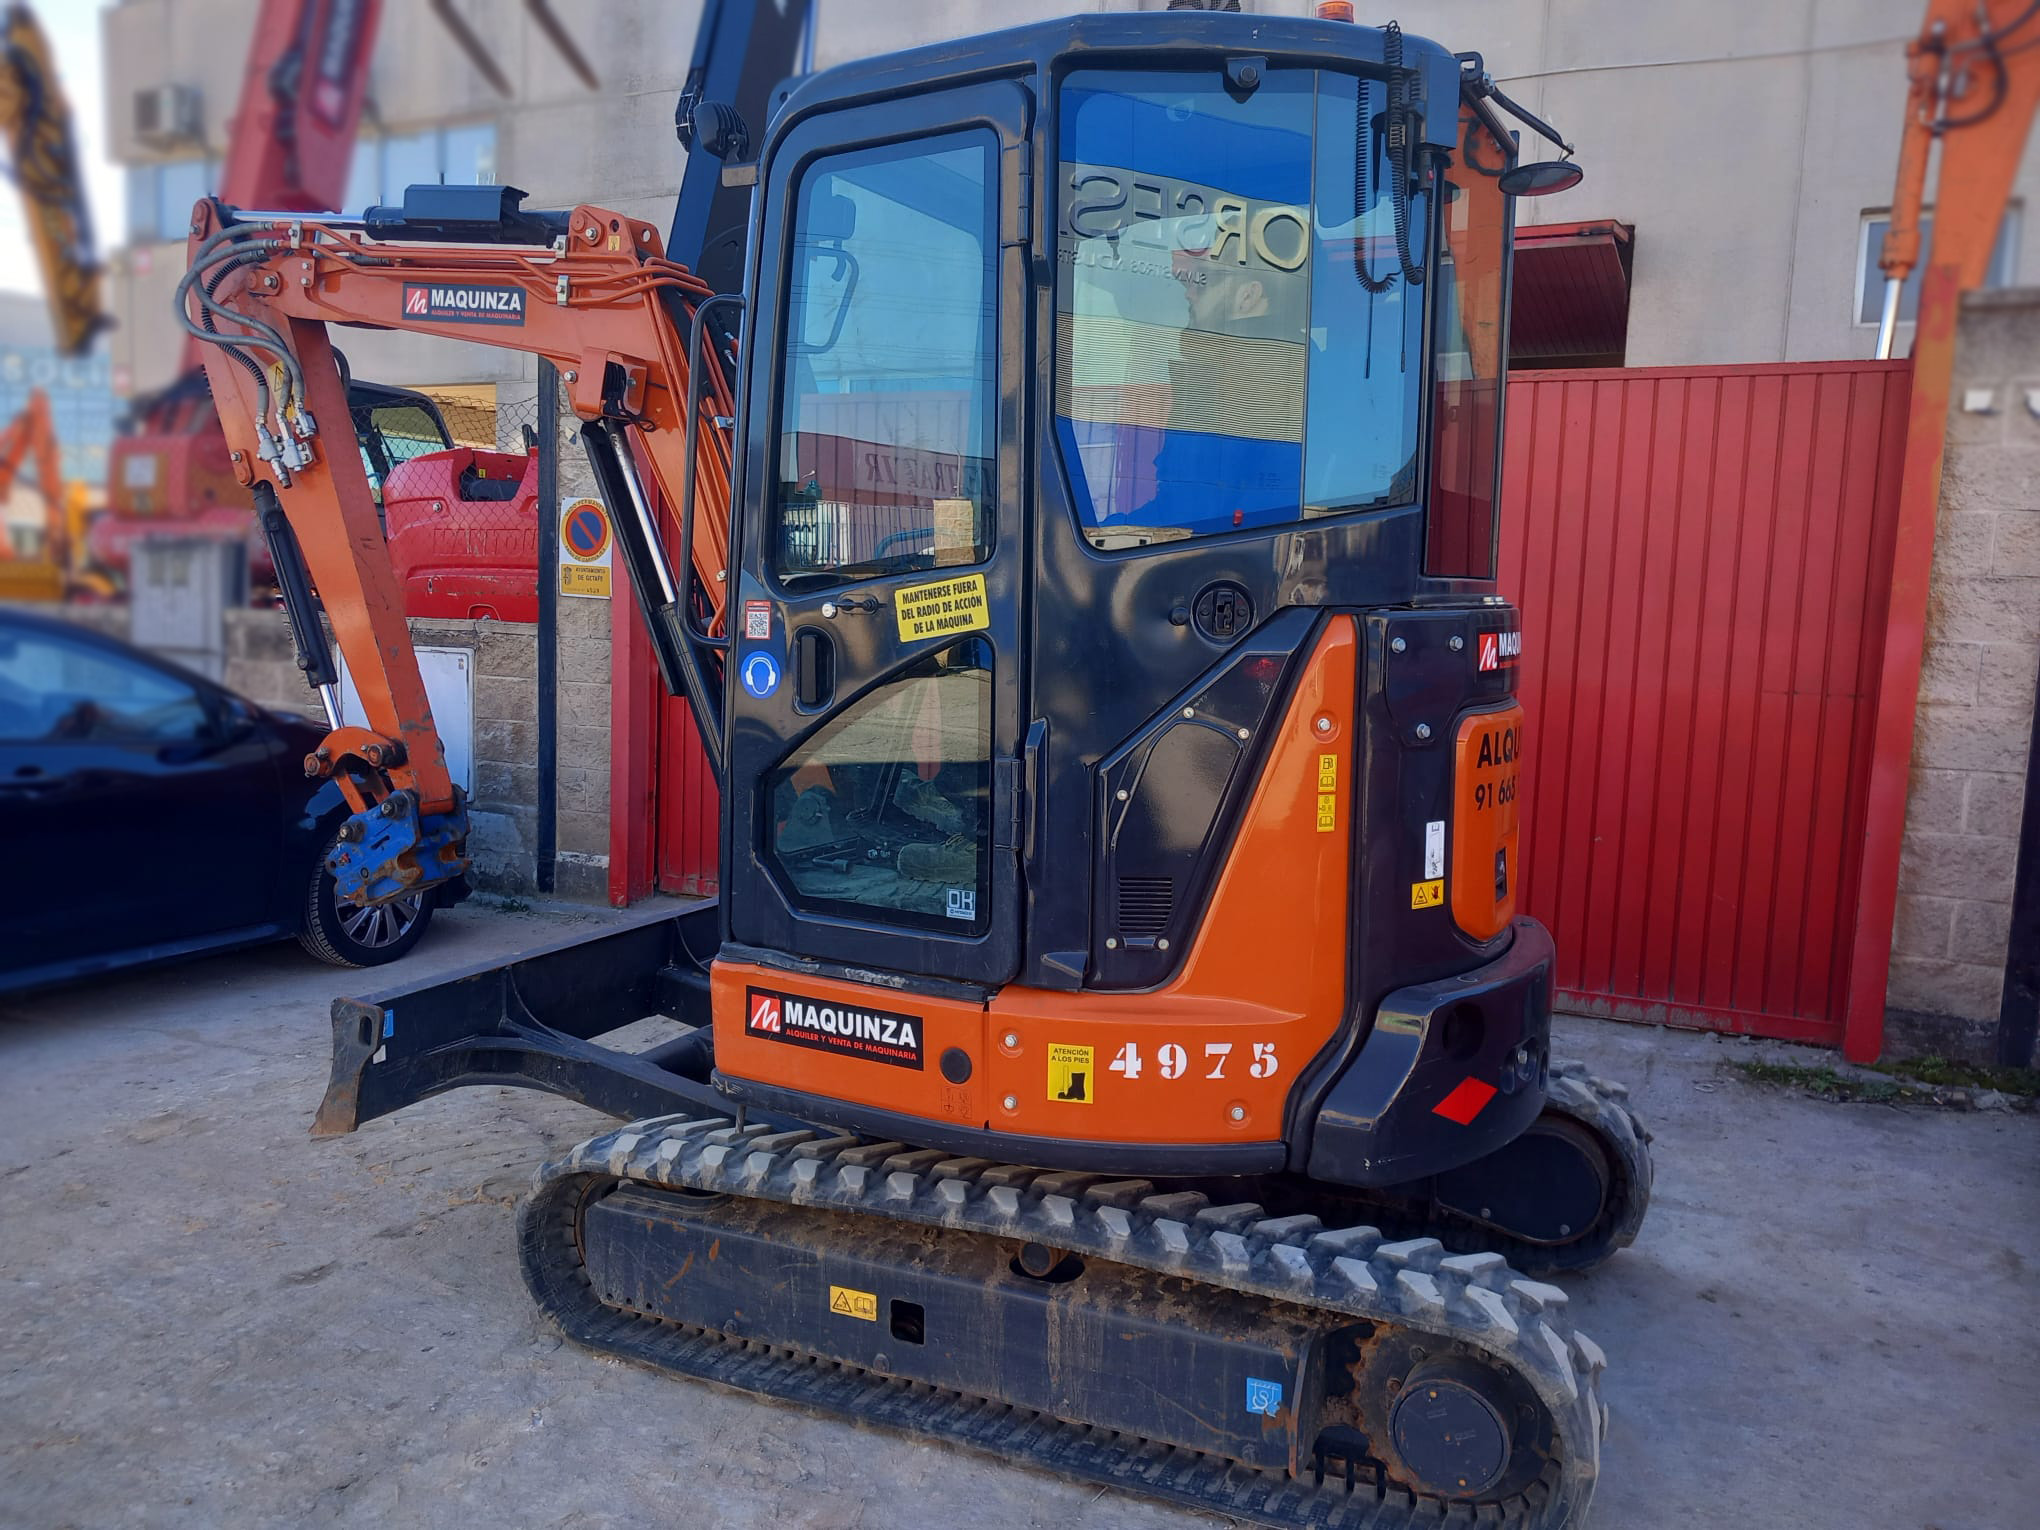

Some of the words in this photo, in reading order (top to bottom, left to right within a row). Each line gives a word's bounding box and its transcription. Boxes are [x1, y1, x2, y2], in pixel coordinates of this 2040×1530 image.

[431, 289, 521, 310] MAQUINZA
[902, 585, 951, 604] MANTENERSE
[952, 580, 978, 595] FUERA
[901, 608, 915, 620] DEL
[916, 603, 941, 618] RADIO
[942, 601, 953, 613] DE
[954, 593, 982, 611] ACCIÓN
[914, 622, 924, 634] DE
[925, 620, 935, 632] LA
[936, 614, 974, 631] MÁQUINA
[1475, 783, 1493, 811] 91
[784, 1001, 917, 1048] MAQUINZA
[785, 1028, 819, 1042] ALQUILER
[821, 1035, 828, 1043] Y
[828, 1037, 852, 1048] VENTA
[853, 1041, 864, 1050] DE
[865, 1043, 917, 1061] MAQUINARIA
[1053, 1047, 1089, 1057] ATENCIÓN
